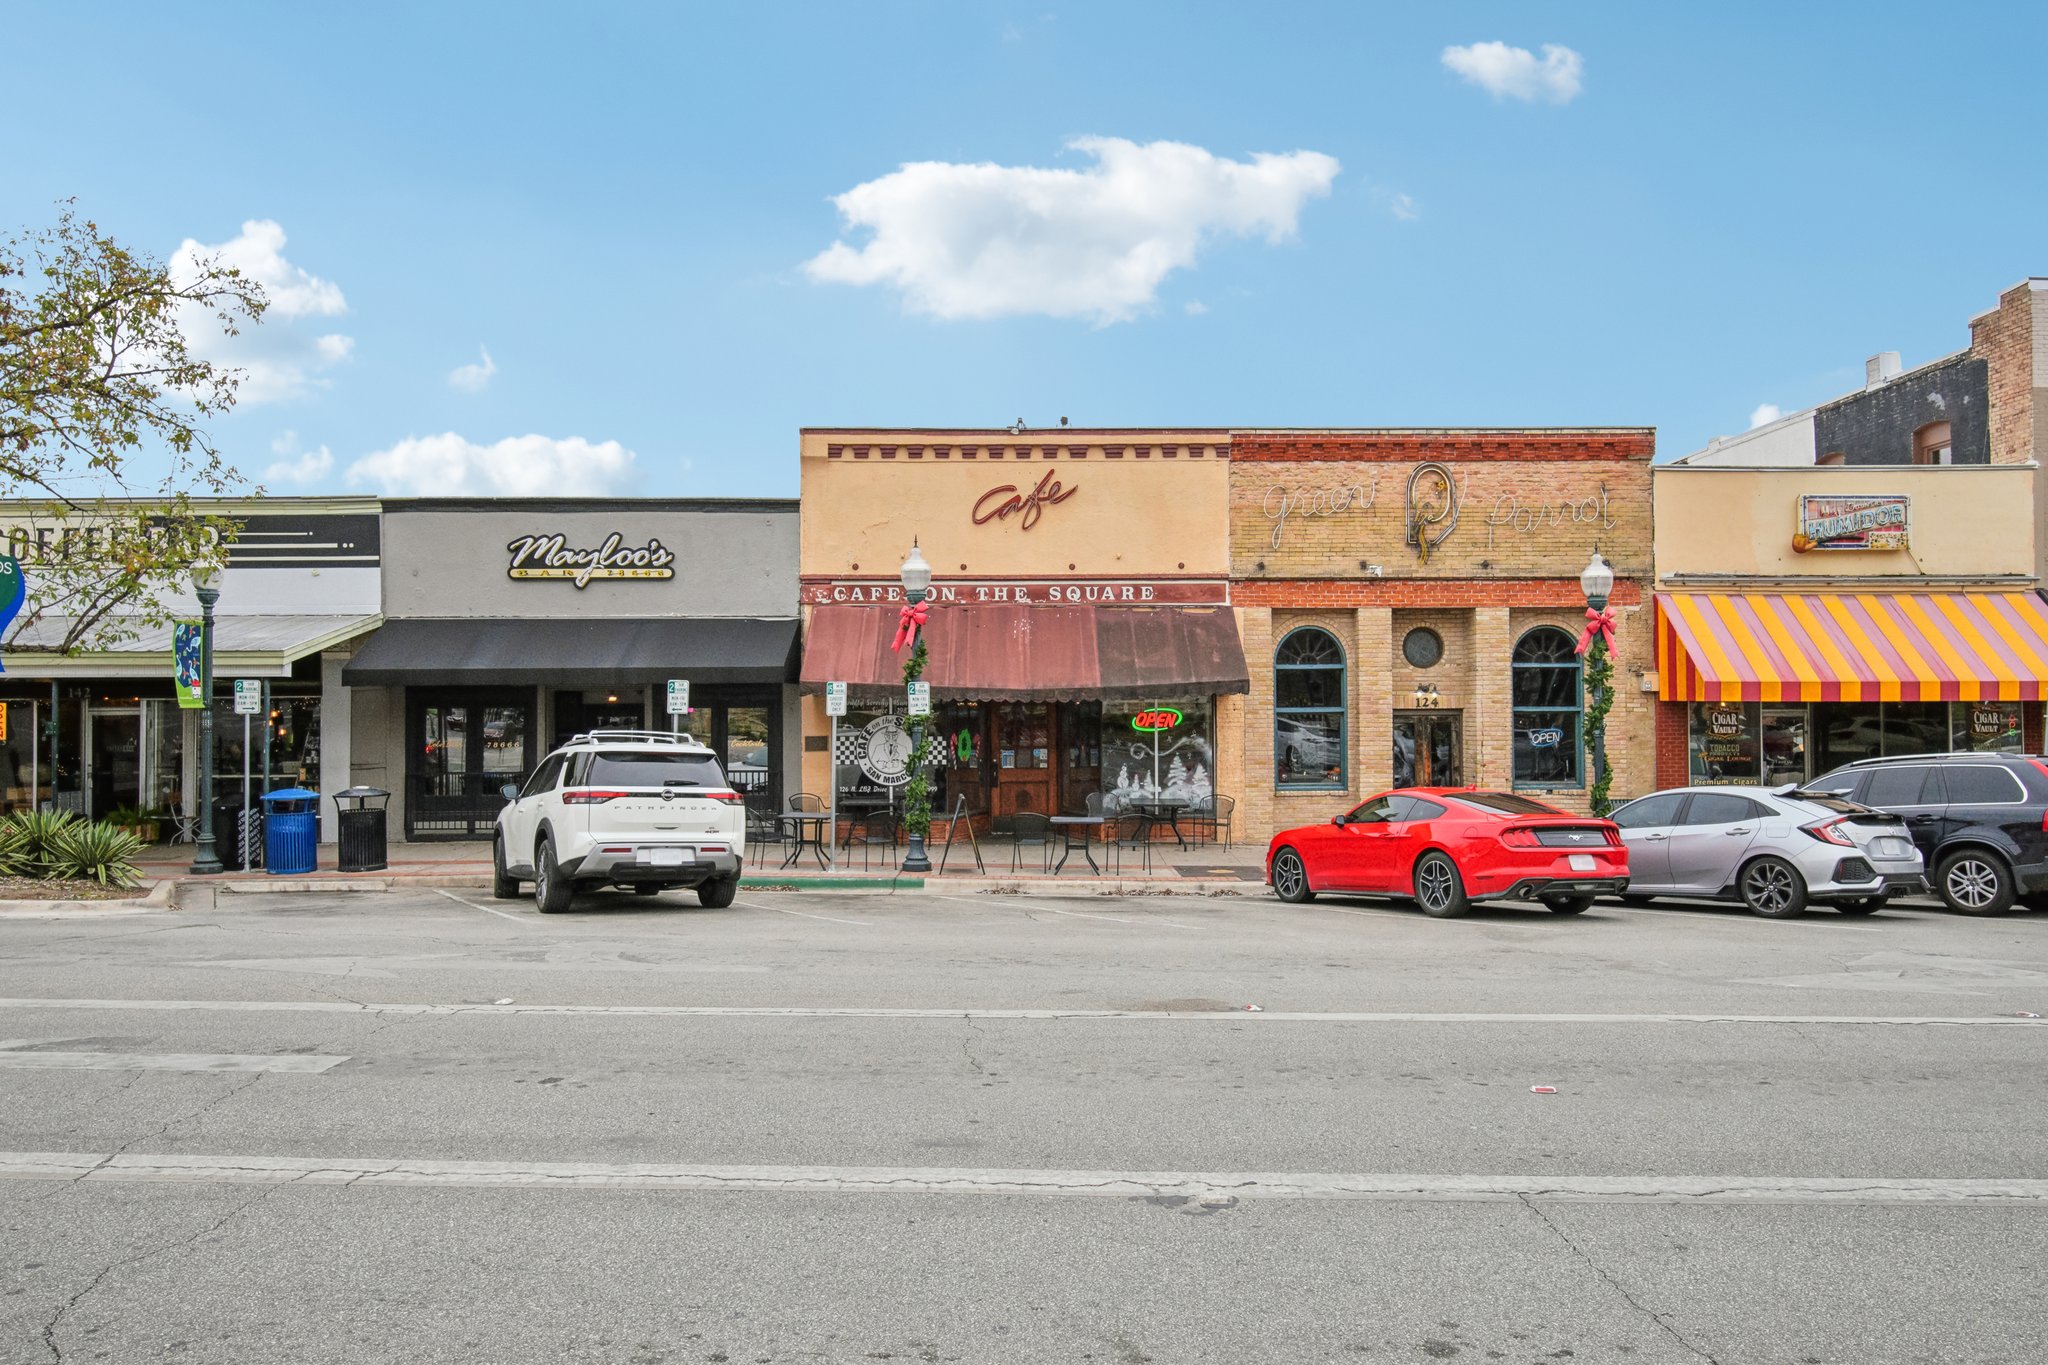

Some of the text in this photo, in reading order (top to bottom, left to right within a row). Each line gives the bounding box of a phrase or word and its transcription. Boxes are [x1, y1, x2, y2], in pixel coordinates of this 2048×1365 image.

[972, 469, 1078, 529] Cafe
[1808, 503, 1904, 541] HUMIDOR
[510, 534, 673, 587] Mayloo's
[516, 569, 664, 577] BAR 78666
[834, 586, 1155, 602] CAFE ON THE SQUARE
[1415, 697, 1439, 708] 124
[1135, 711, 1178, 728] OPEN
[1713, 725, 1737, 733] VAULT
[1974, 724, 1999, 733] VAULT
[486, 741, 520, 749] 78666
[857, 726, 875, 760] CAFE
[1531, 731, 1561, 744] OPEN
[866, 766, 881, 781] SAN
